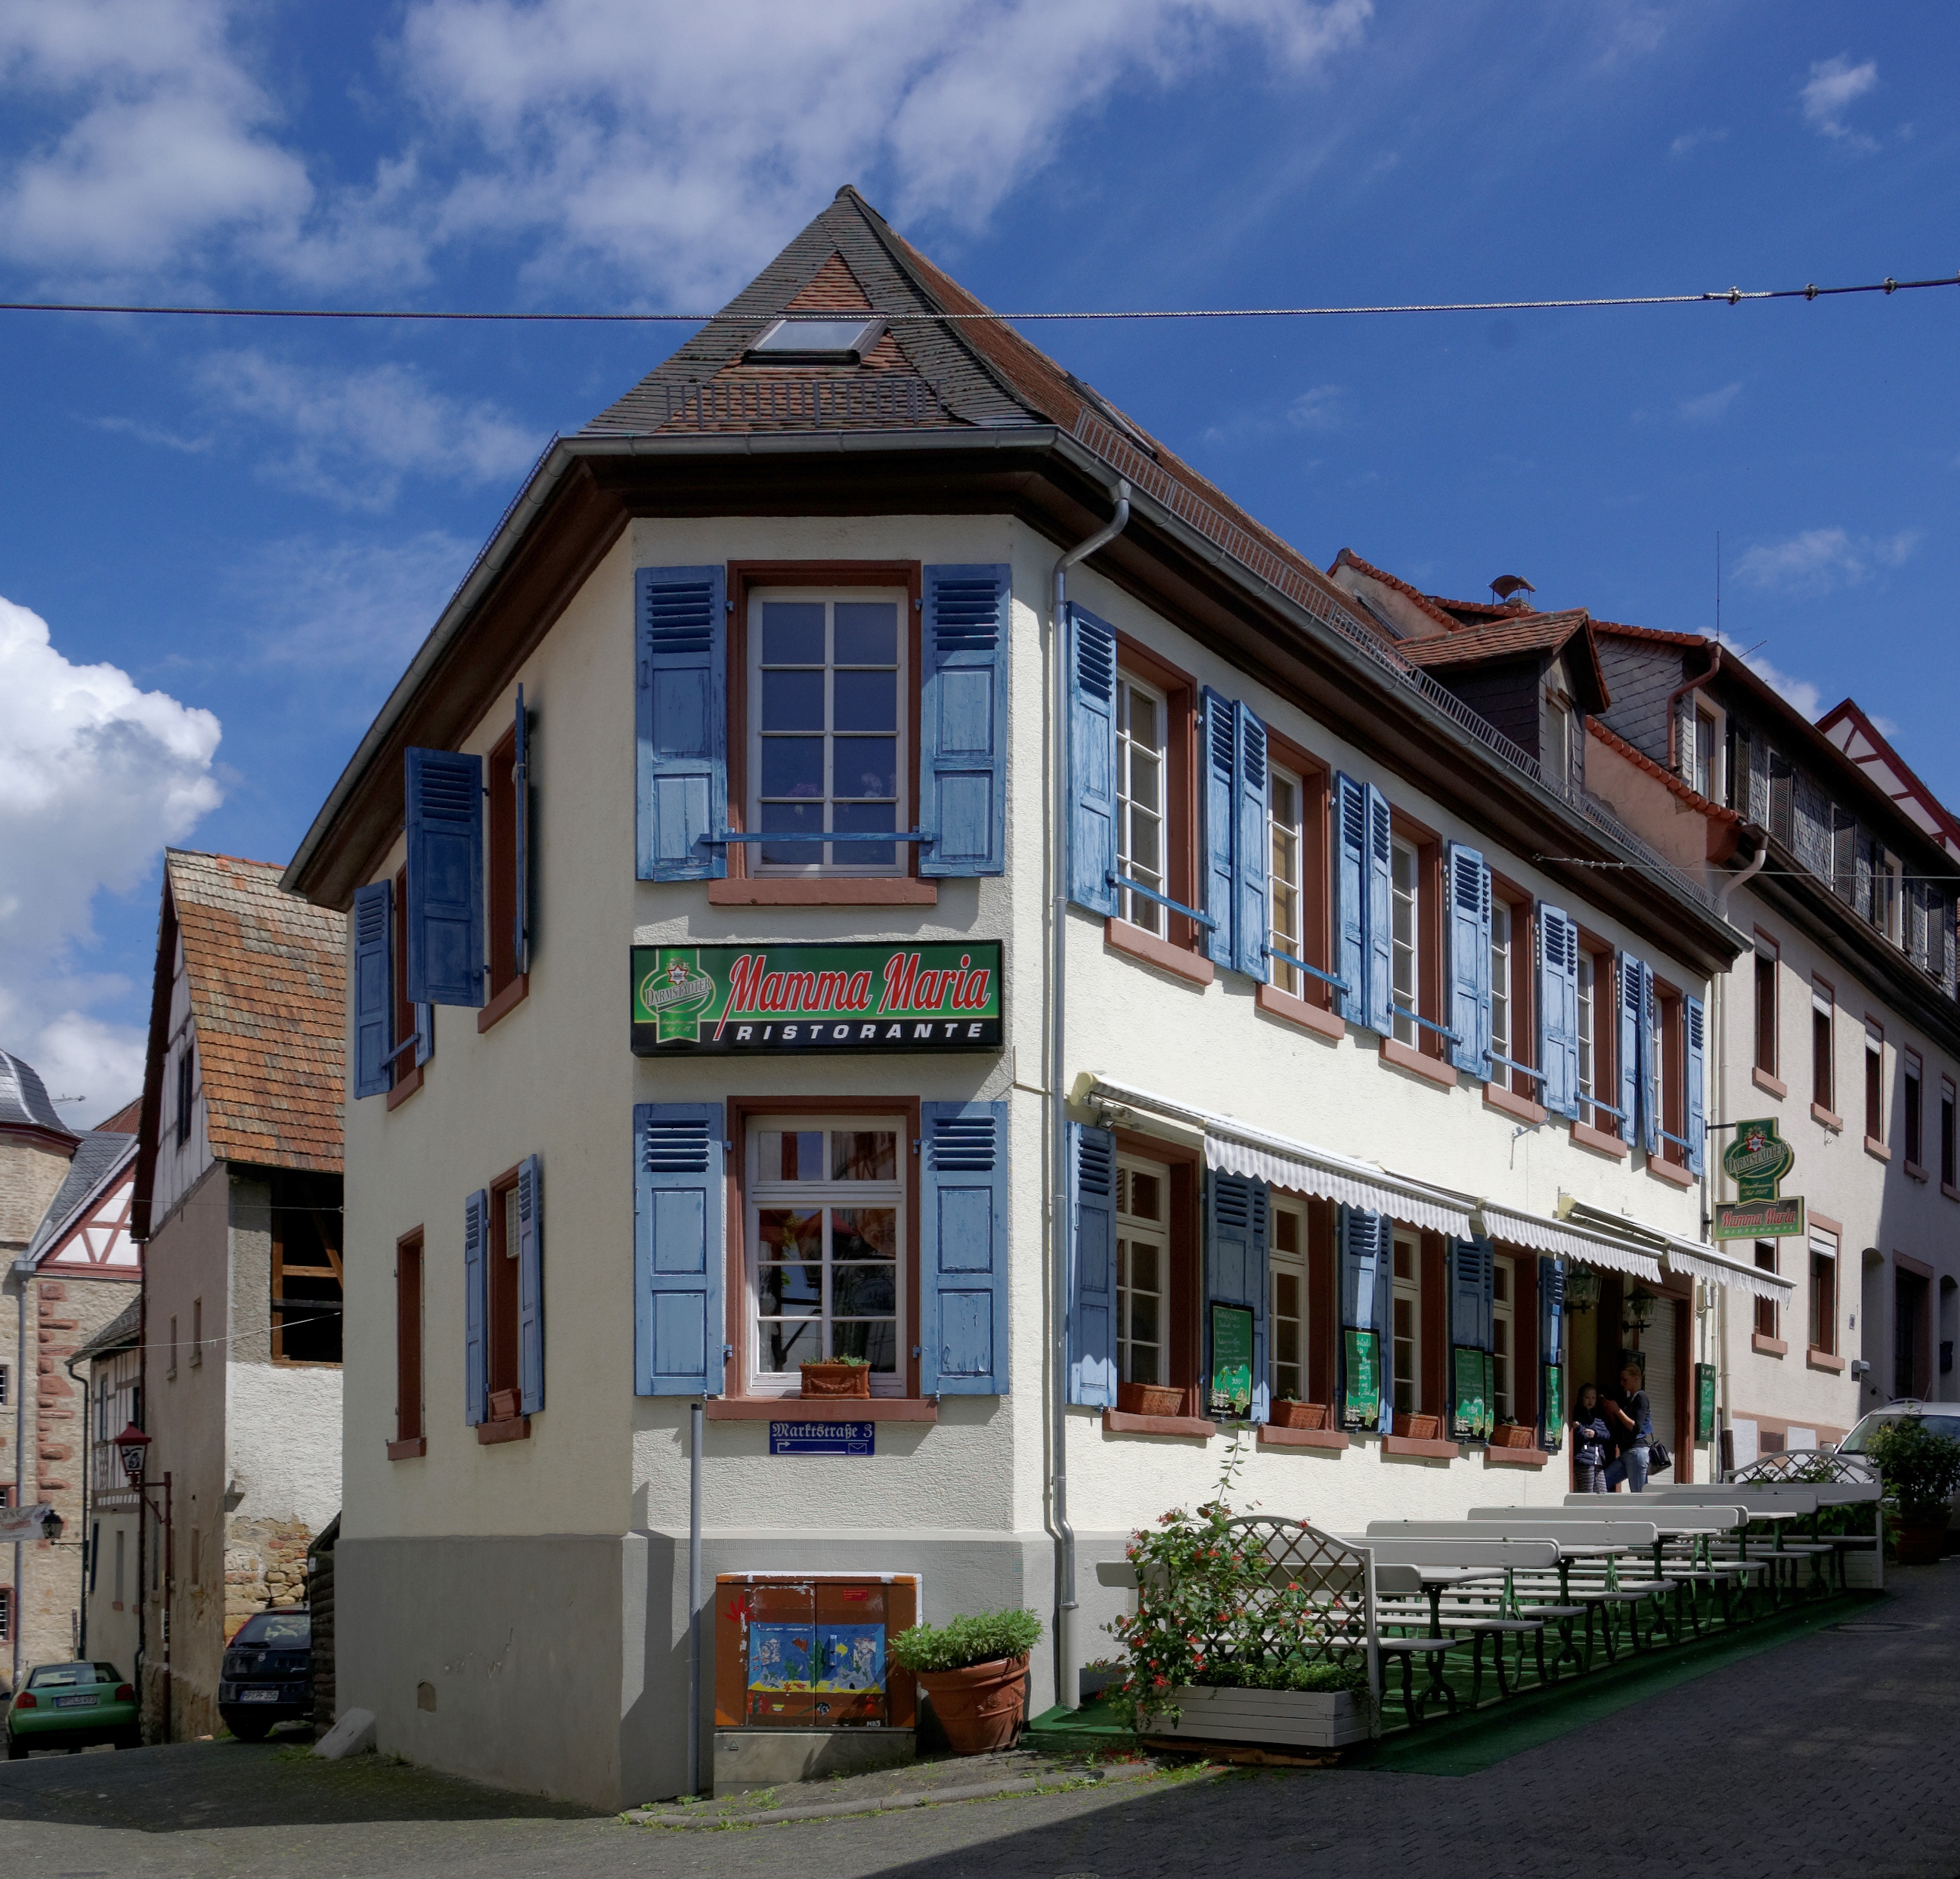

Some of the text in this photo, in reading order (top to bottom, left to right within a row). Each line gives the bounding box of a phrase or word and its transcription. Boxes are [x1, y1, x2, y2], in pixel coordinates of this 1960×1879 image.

[712, 952, 991, 1041] Mamma Maria
[735, 1023, 983, 1041] RISTORANTE
[1717, 1208, 1796, 1236] Mamma Maria
[1724, 1225, 1794, 1234] RISTORANTE
[772, 1422, 873, 1439] Marktstraße 3
